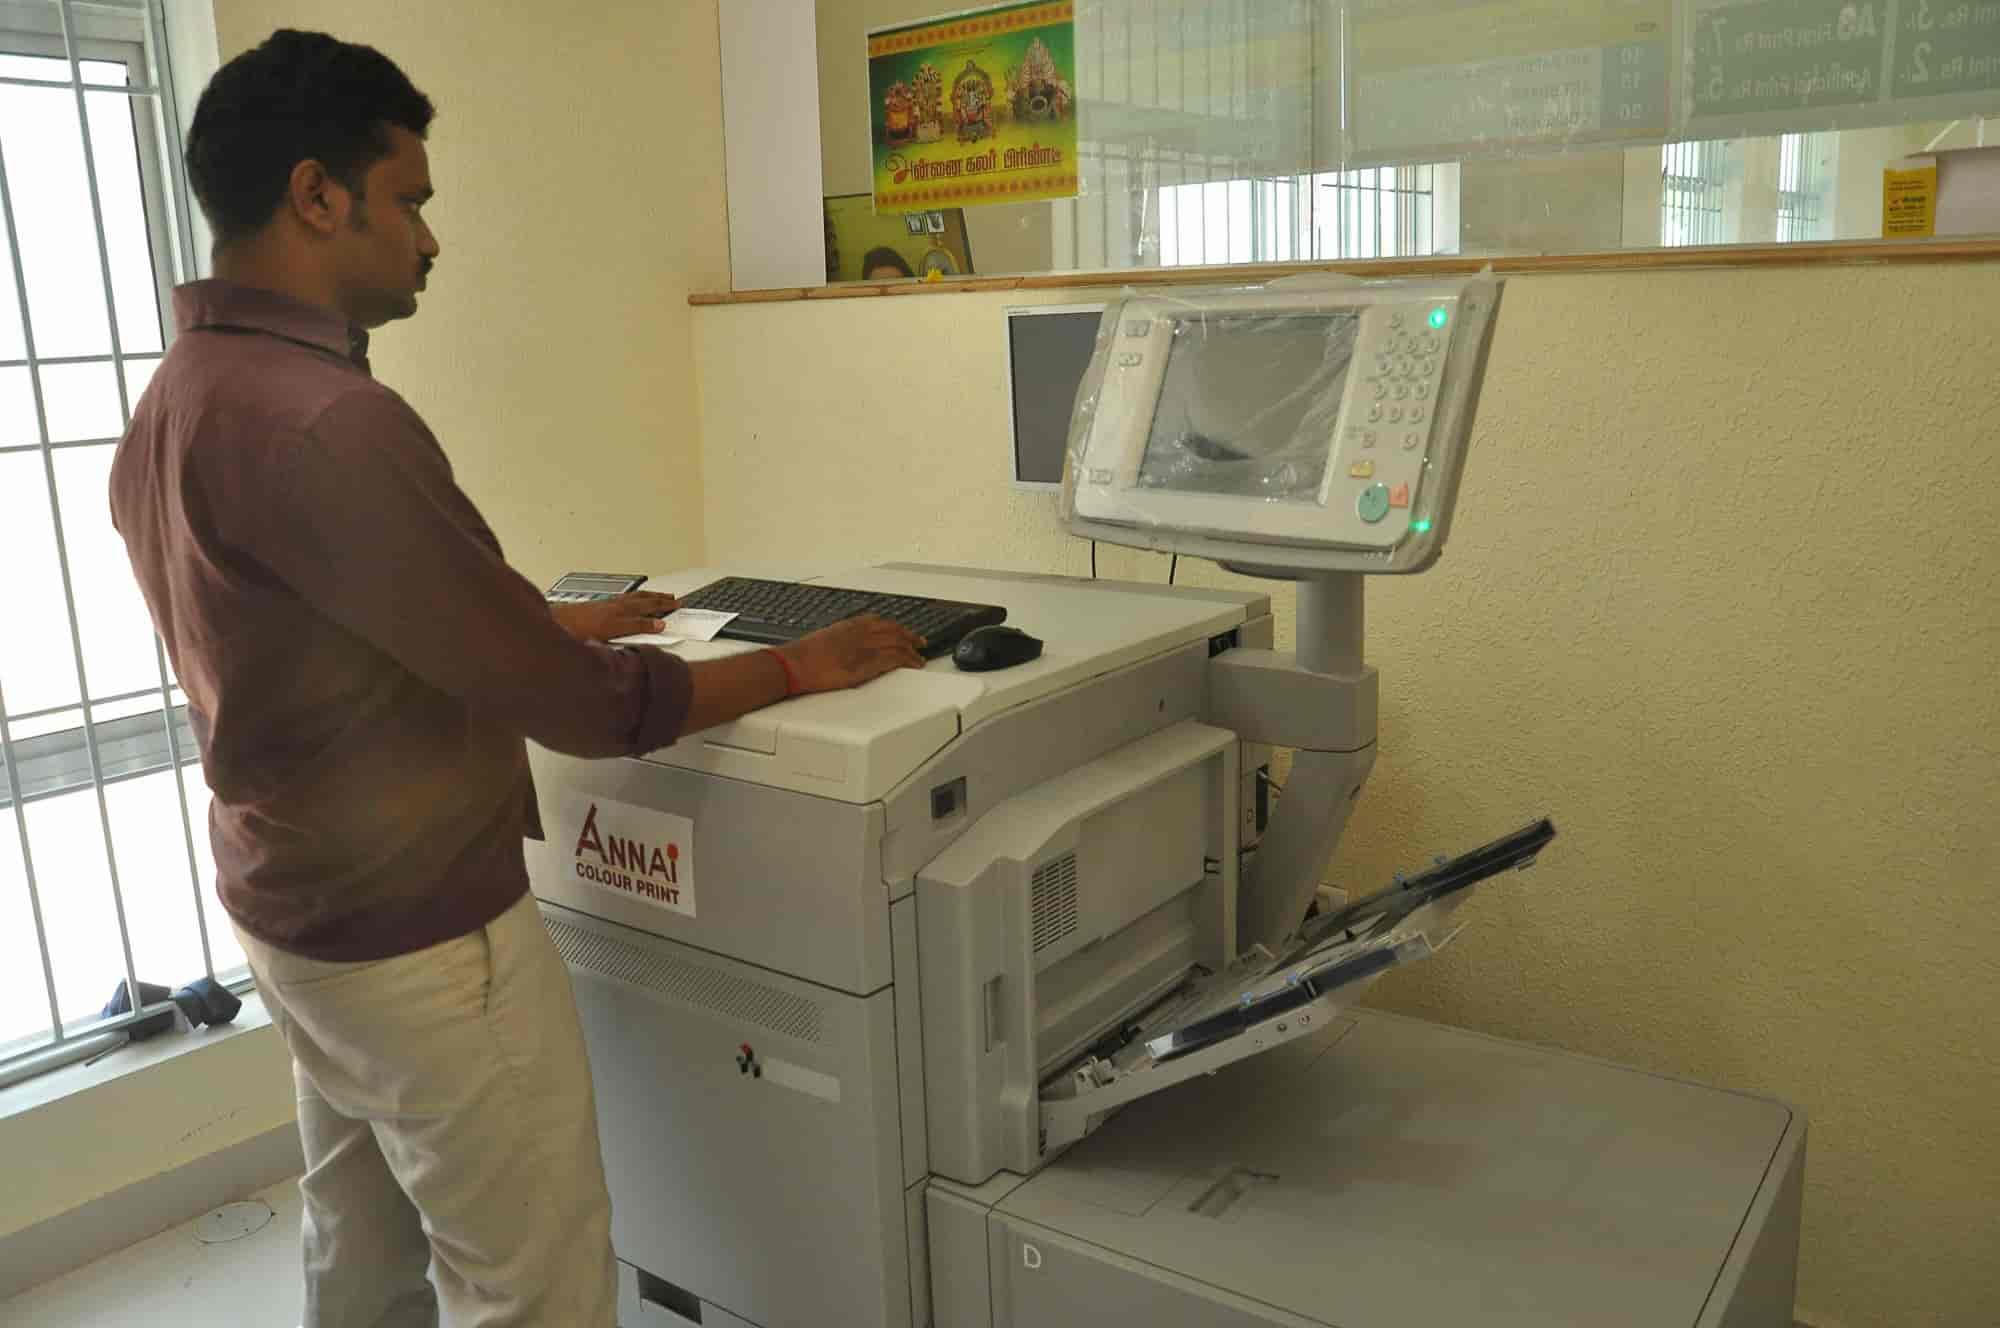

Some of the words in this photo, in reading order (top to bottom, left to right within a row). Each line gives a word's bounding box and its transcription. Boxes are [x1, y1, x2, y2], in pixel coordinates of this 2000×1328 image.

[576, 862, 632, 892] COLOUR
[636, 879, 680, 905] PRINT
[1023, 1243, 1041, 1268] D
